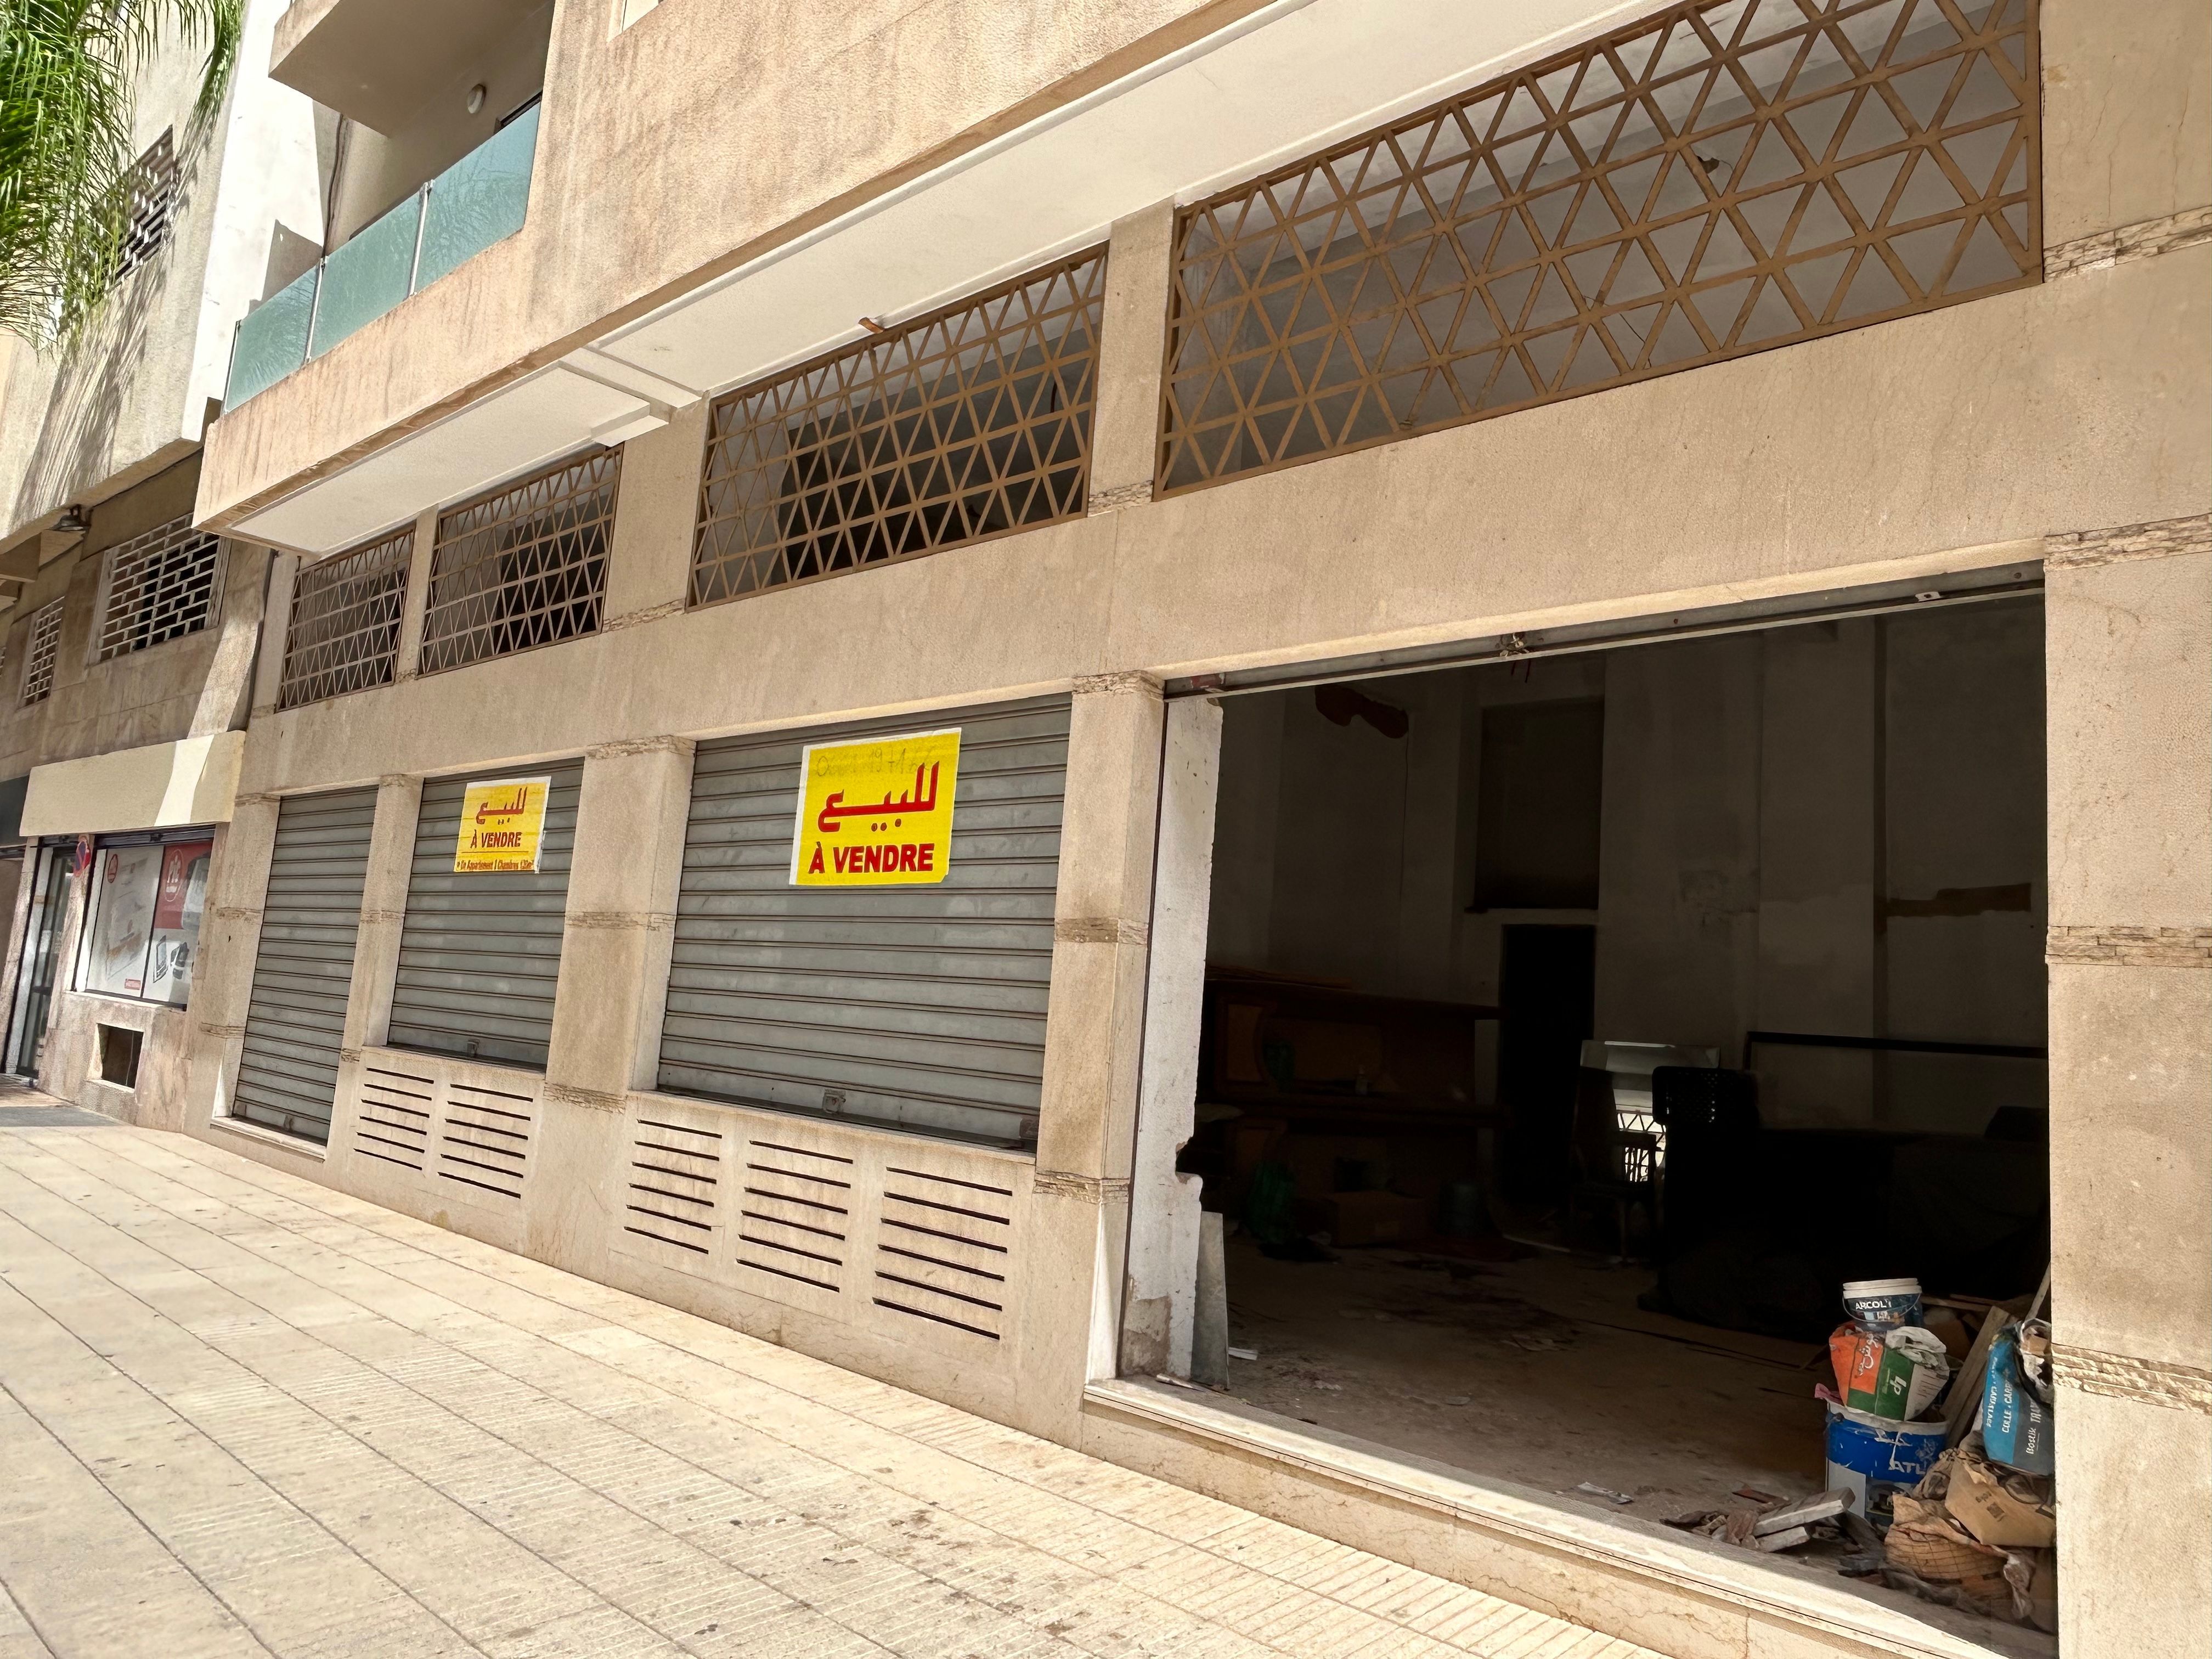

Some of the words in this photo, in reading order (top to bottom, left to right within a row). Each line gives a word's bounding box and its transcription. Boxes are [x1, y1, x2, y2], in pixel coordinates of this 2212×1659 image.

[476, 787, 527, 825] للبيع
[817, 761, 939, 832] للبيع
[470, 830, 477, 848] À
[481, 832, 522, 848] VENDRE
[808, 842, 825, 874] À
[833, 843, 934, 873] VENDRE
[2002, 1409, 2012, 1433] COLLE
[1888, 1461, 1927, 1475] ATL
